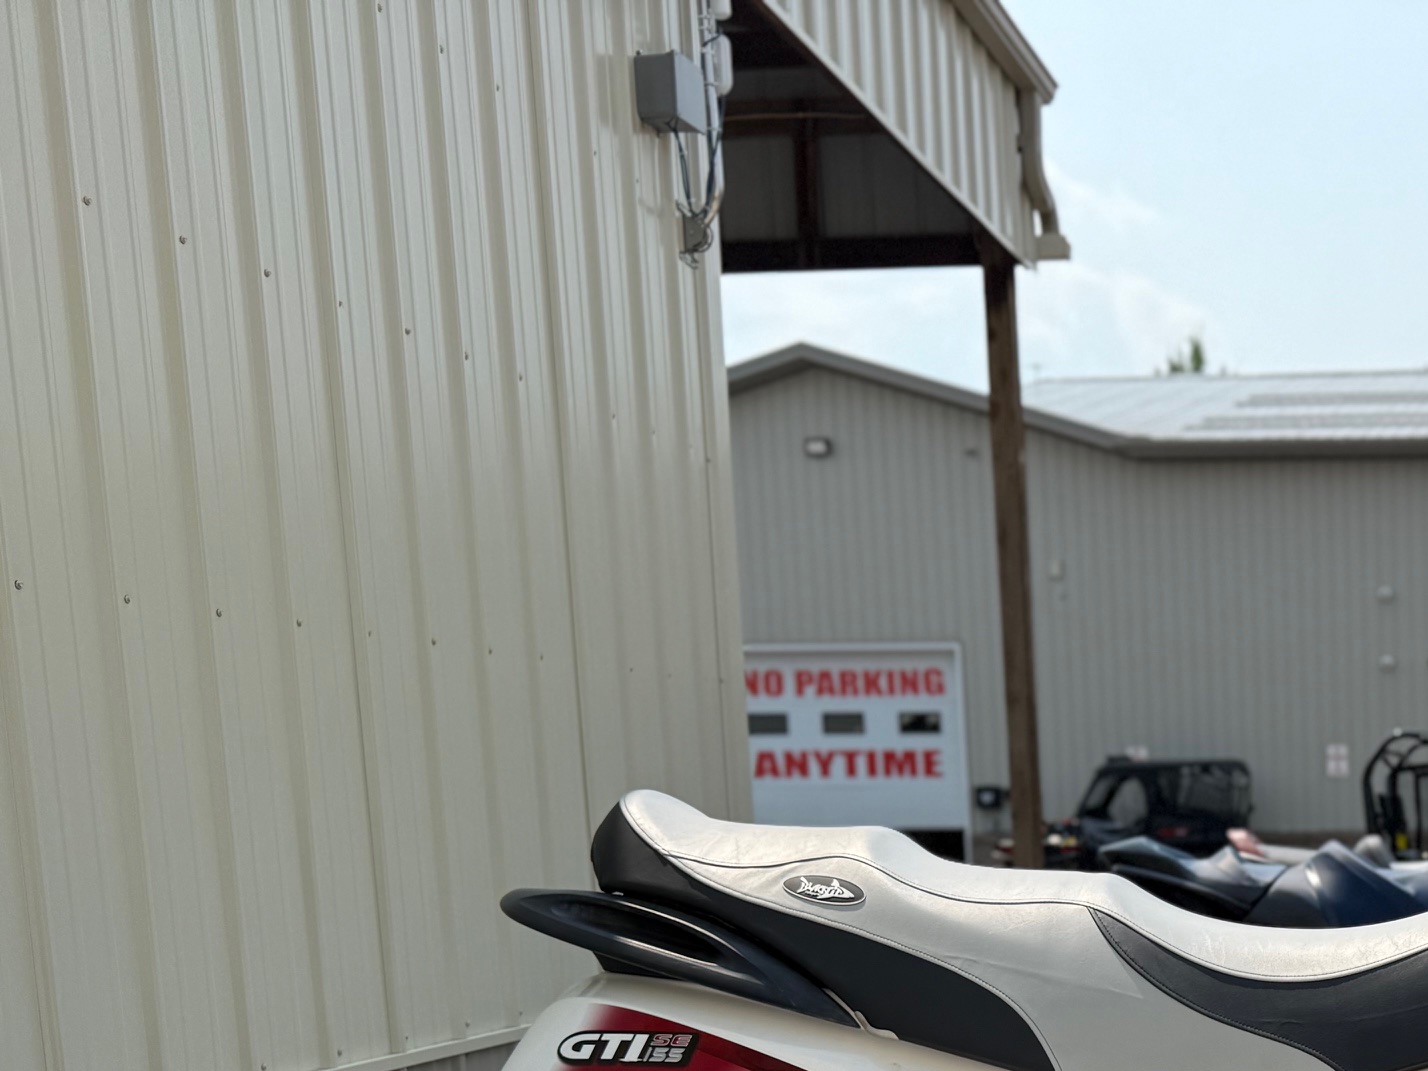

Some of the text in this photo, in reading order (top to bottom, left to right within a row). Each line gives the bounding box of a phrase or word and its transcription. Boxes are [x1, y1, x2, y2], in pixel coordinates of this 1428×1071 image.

[794, 667, 945, 697] PARKING
[753, 749, 943, 780] ANYTIME
[559, 1032, 693, 1063] GTI SE
